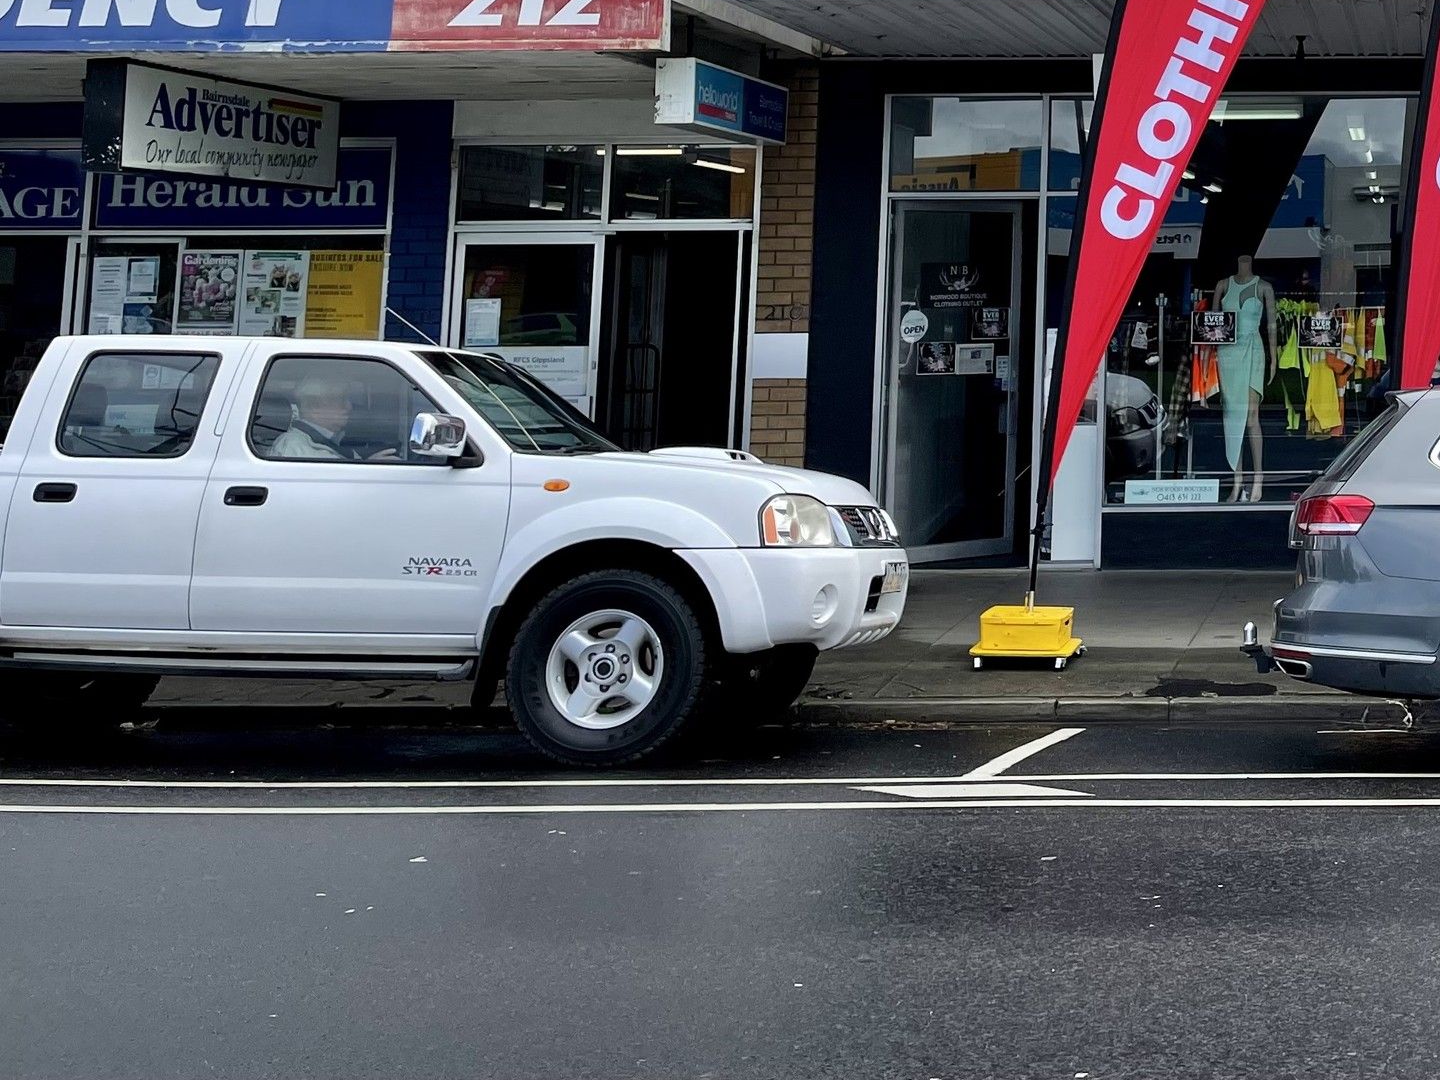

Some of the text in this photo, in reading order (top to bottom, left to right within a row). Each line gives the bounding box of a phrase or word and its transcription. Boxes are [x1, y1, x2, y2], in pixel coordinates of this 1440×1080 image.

[202, 88, 251, 108] Bairnsdale
[145, 82, 323, 150] Advertiser
[146, 135, 319, 180] Our local community newspaper
[903, 324, 925, 336] OPEN
[408, 557, 472, 567] NAVARA
